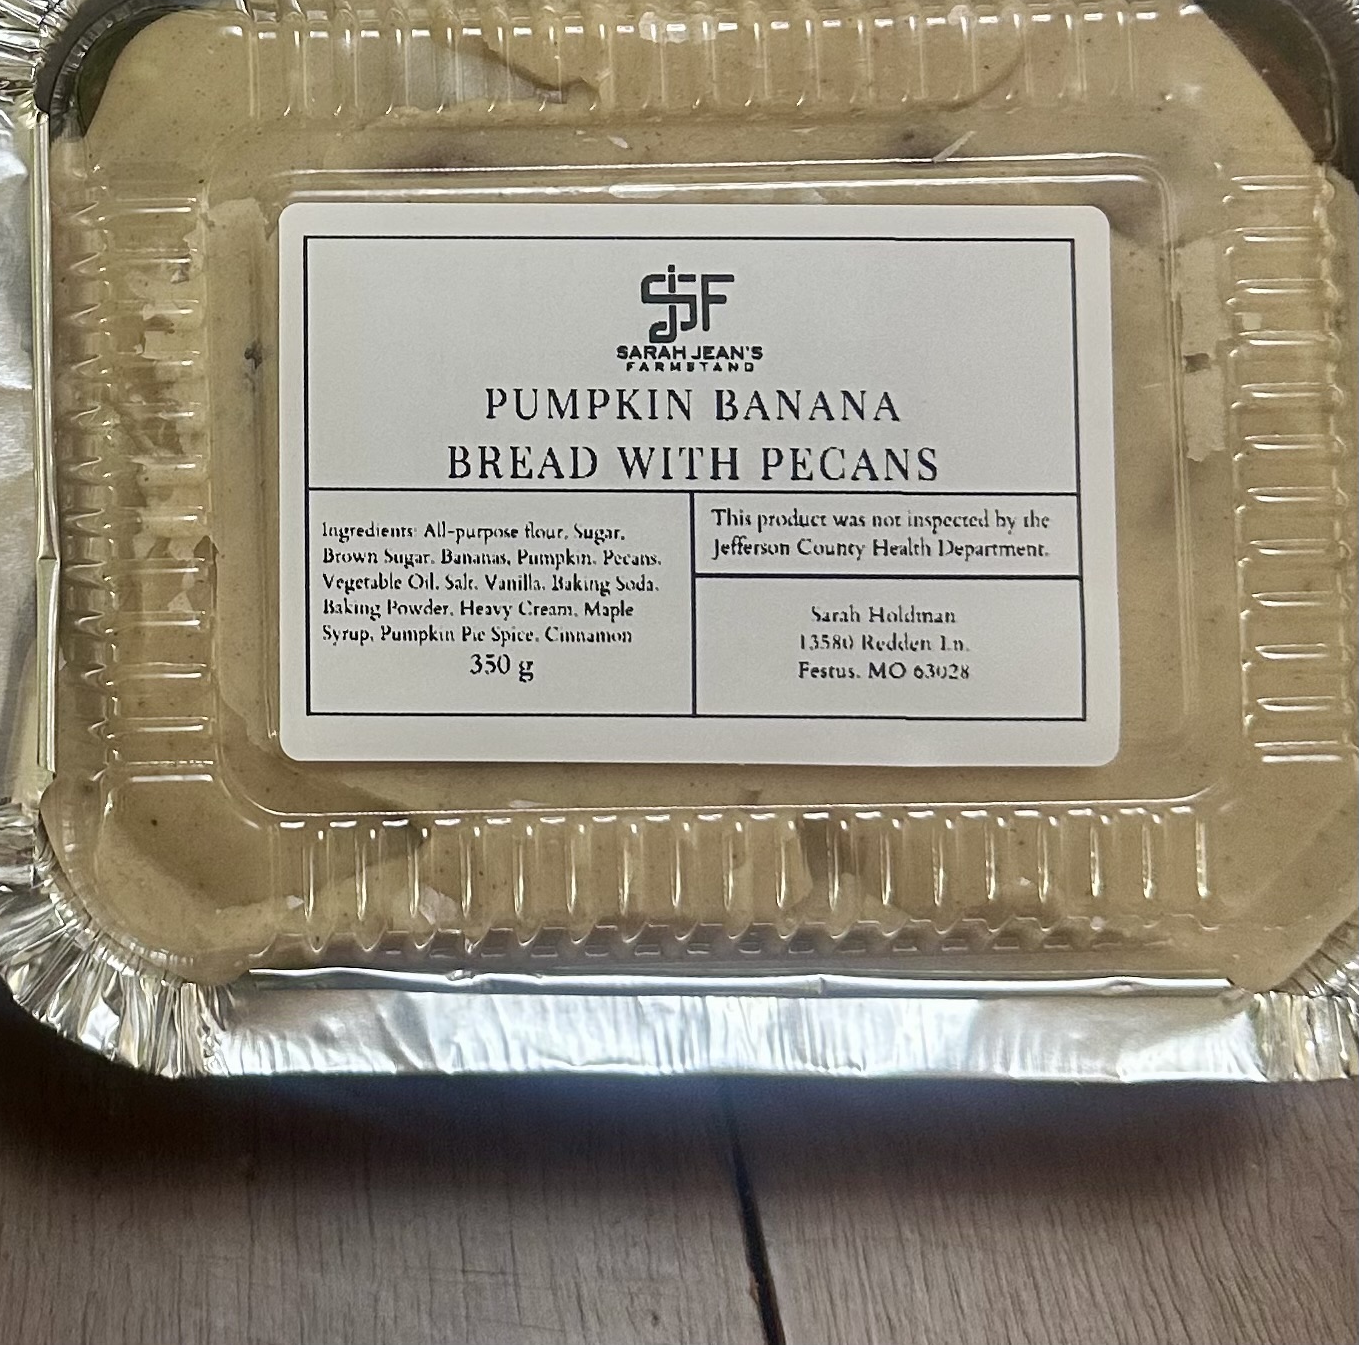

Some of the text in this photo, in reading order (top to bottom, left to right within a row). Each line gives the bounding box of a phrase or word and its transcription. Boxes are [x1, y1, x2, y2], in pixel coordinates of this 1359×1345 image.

[616, 343, 764, 361] SARAH JEAN'S
[626, 362, 755, 373] FARMSTAND
[485, 388, 901, 422] PUMPKIN BANANA
[448, 446, 938, 482] BREAD WITH PECANS
[424, 520, 519, 544] All-purpose
[711, 507, 1050, 533] This product was not inspected by the
[323, 548, 379, 565] Brown
[711, 535, 790, 561] Jefferson
[797, 538, 866, 561] County
[873, 537, 932, 557] Health
[323, 572, 402, 595] Vegetable
[551, 573, 611, 598] Baking
[324, 597, 382, 622] Baking
[461, 600, 513, 622] Heavy
[584, 600, 634, 624] Maple
[812, 604, 956, 624] Sarah Holdman
[380, 624, 455, 647] Pumpkin
[462, 626, 486, 642] Pie
[545, 626, 632, 643] Cinnamon
[862, 632, 932, 652] Redden
[470, 654, 534, 683] 350 g
[868, 662, 908, 680] MO
